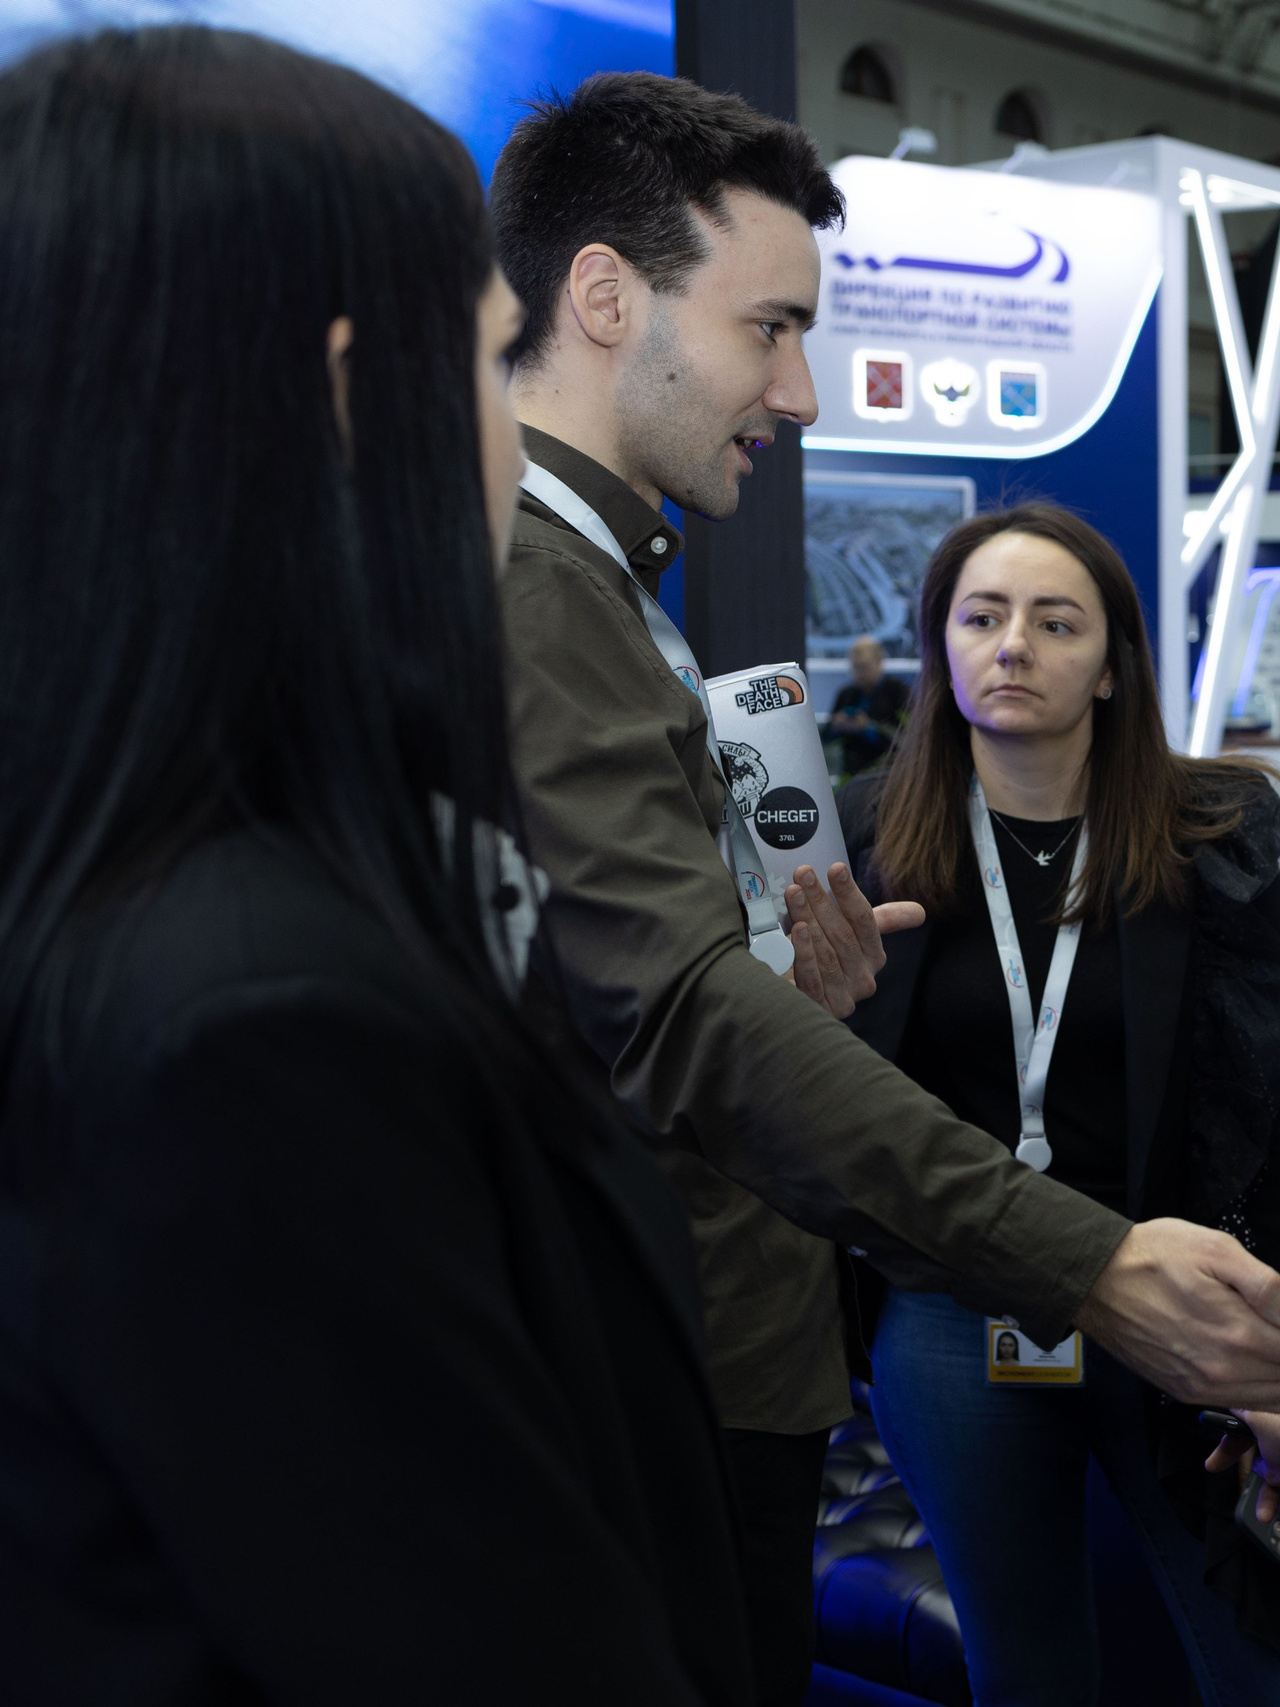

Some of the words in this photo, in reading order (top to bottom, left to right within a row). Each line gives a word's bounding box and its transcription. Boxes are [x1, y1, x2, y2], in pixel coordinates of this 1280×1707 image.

[751, 677, 777, 692] THE
[736, 687, 779, 706] DEATH
[747, 697, 782, 714] FACE
[757, 809, 817, 823] CHEGET
